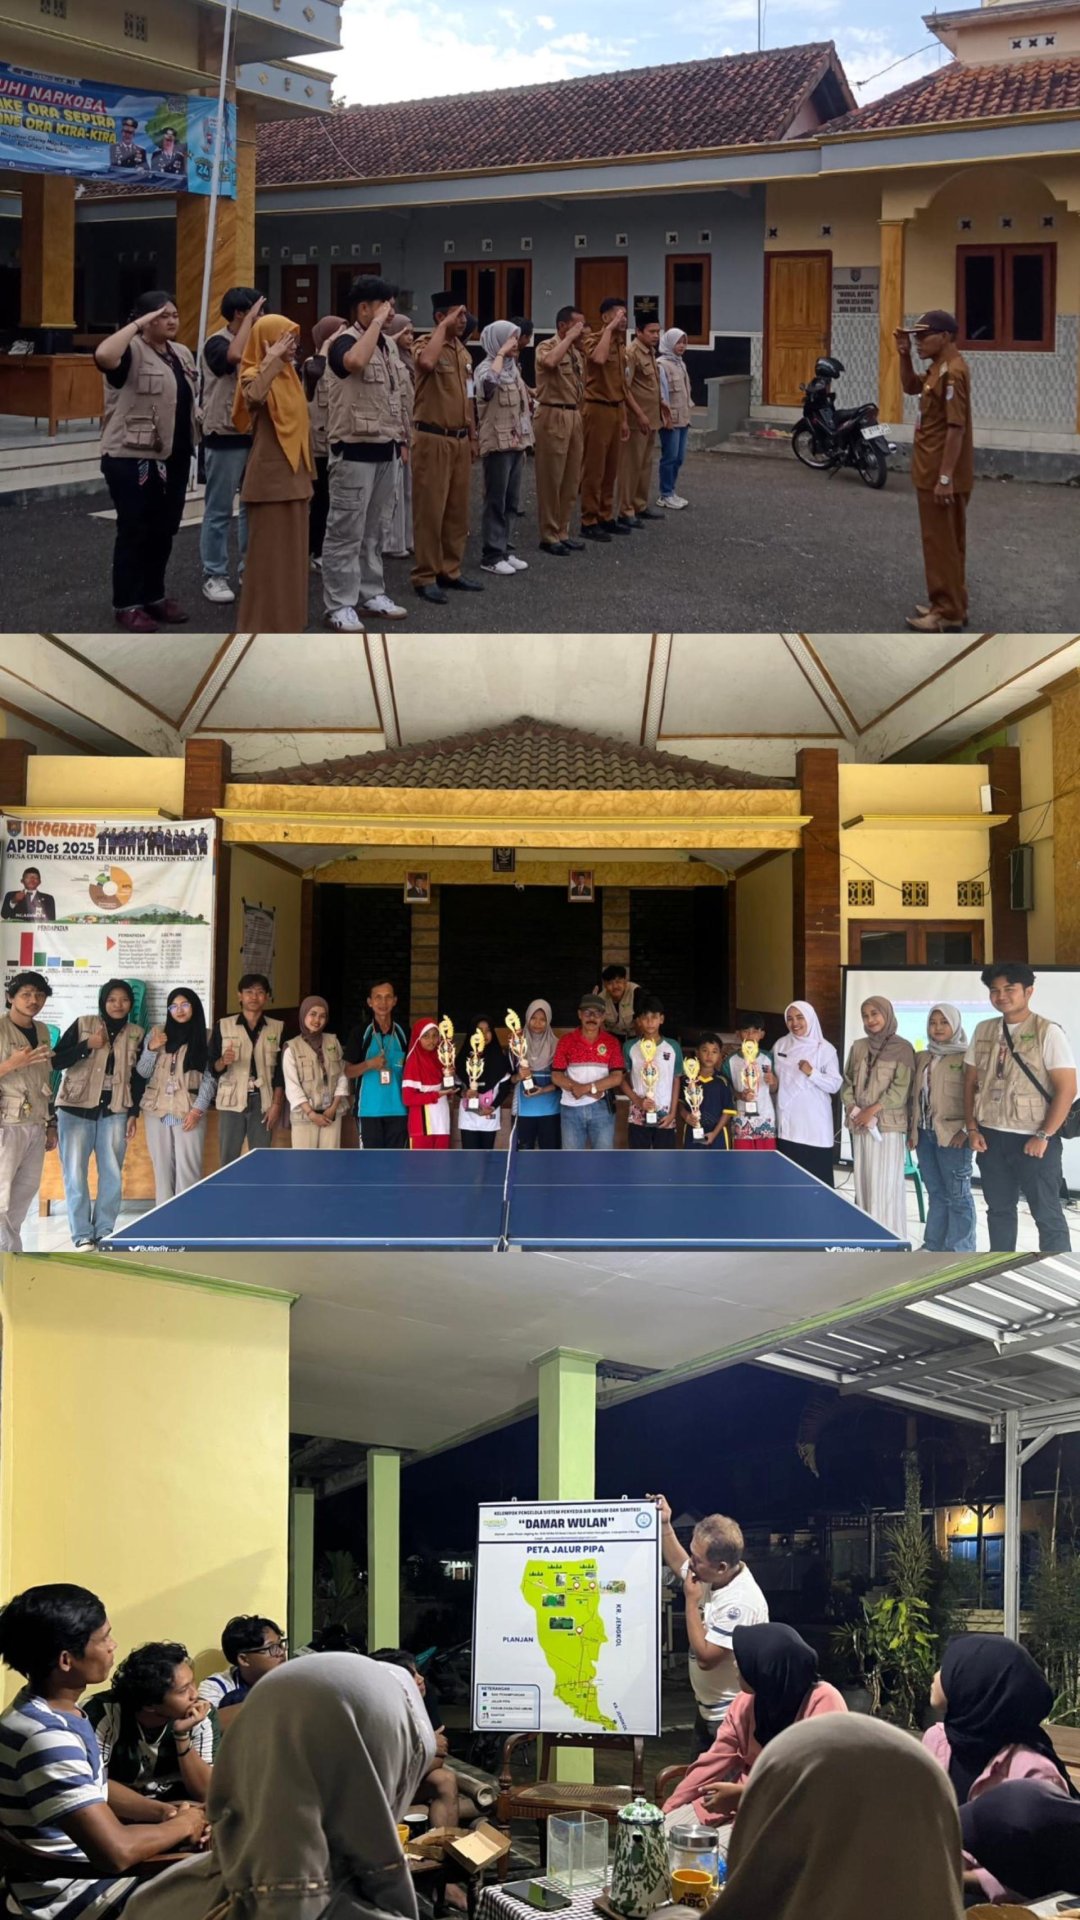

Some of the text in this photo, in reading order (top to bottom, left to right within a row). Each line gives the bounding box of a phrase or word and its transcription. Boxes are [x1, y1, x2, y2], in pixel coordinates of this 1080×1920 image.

[30, 86, 104, 112] NARKOBA
[27, 102, 60, 119] ORA
[63, 109, 116, 129] SEPIRA
[26, 117, 53, 133] ORA
[56, 123, 117, 144] KIRA-KIRA
[23, 821, 96, 838] INFOGRAFIS
[6, 839, 95, 855] APBDes 2025
[583, 1545, 605, 1553] PIPA
